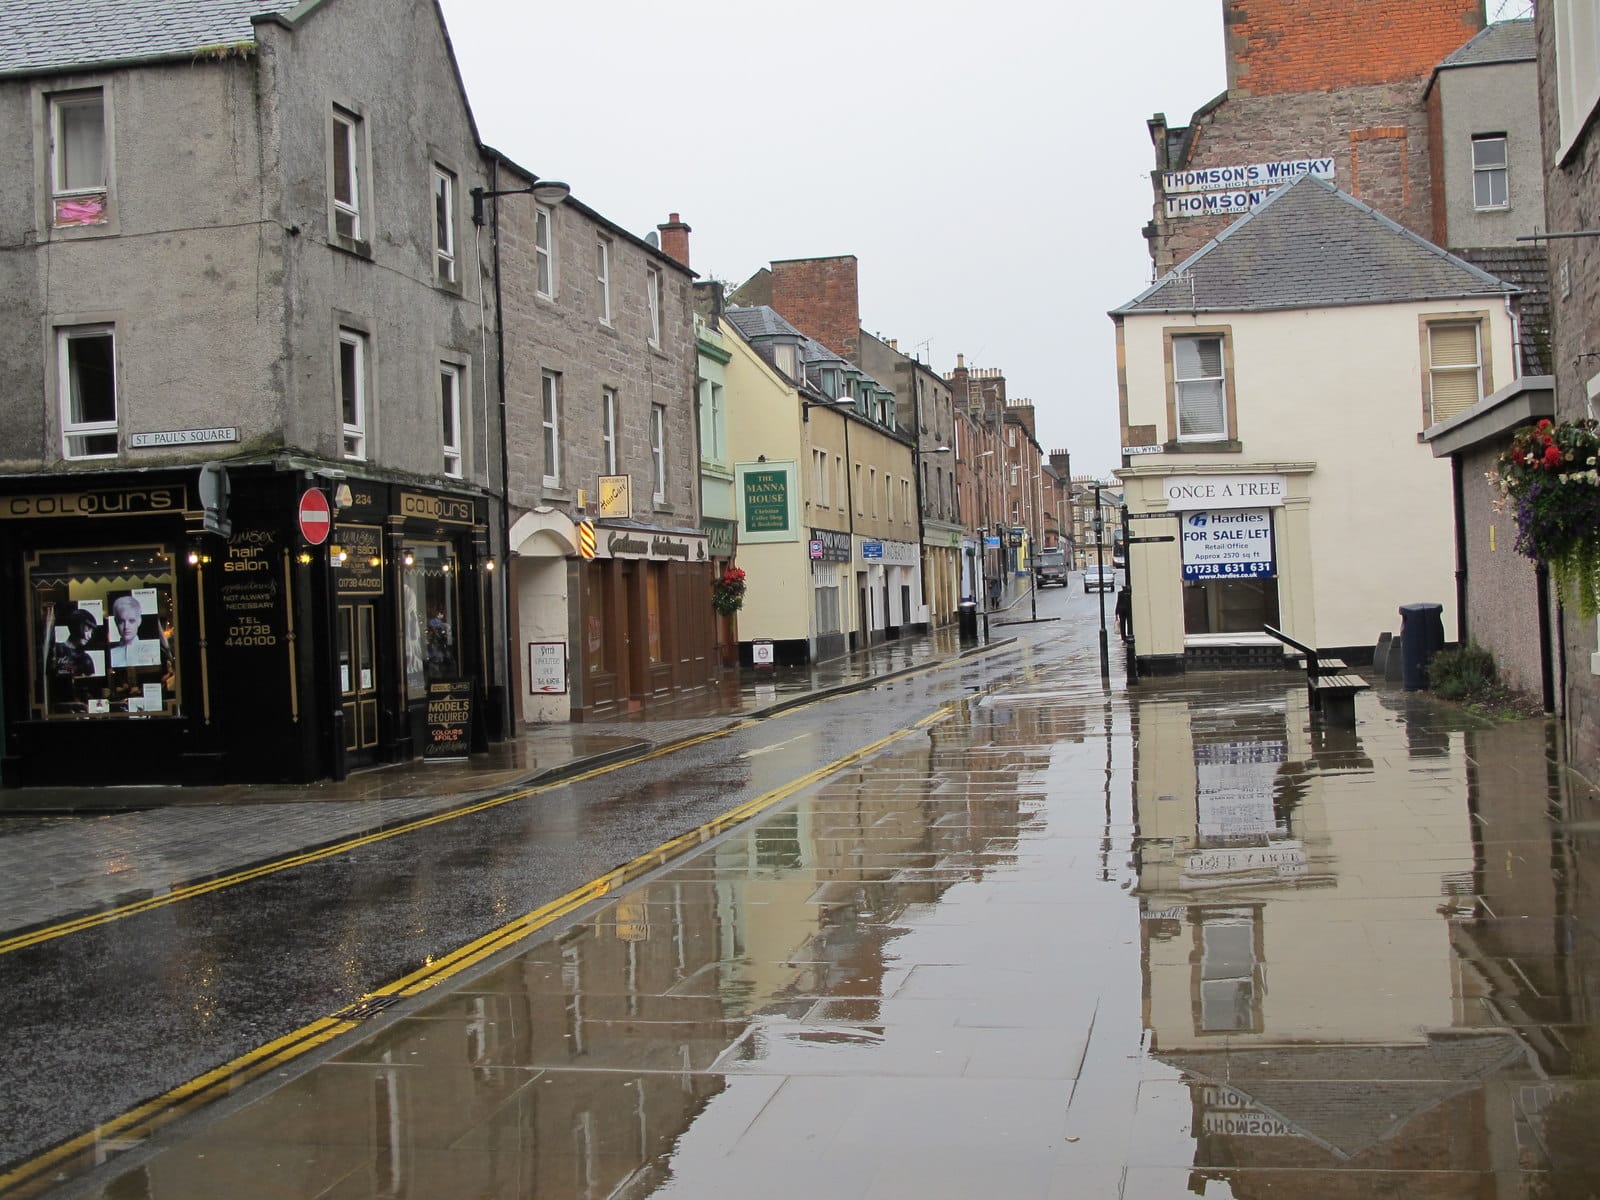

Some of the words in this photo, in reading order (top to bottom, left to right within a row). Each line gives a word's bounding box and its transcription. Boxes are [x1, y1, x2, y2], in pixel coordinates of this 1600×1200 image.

[1165, 166, 1258, 188] THOMSON'S
[1267, 159, 1332, 179] WHISKY
[1202, 208, 1222, 216] OLD
[136, 434, 149, 445] ST
[154, 432, 186, 443] PAUL'S
[190, 429, 232, 441] SQUARE
[746, 483, 785, 493] MANNA
[1169, 485, 1216, 499] ONCE
[1222, 484, 1233, 497] A
[1237, 482, 1281, 496] TREE
[355, 494, 372, 505] 234
[749, 494, 785, 504] HOUSE
[1211, 513, 1264, 524] Hardies
[1184, 531, 1208, 541] FOR
[1213, 529, 1269, 541] SALE/LET
[229, 545, 264, 558] hair
[223, 558, 269, 572] salon
[1186, 564, 1219, 574] 01738
[1224, 563, 1245, 573] 631
[1250, 562, 1270, 572] 631
[229, 625, 271, 636] 01738
[224, 636, 276, 647] 440100
[428, 702, 470, 712] MODELS
[427, 711, 469, 722] REQUIRED
